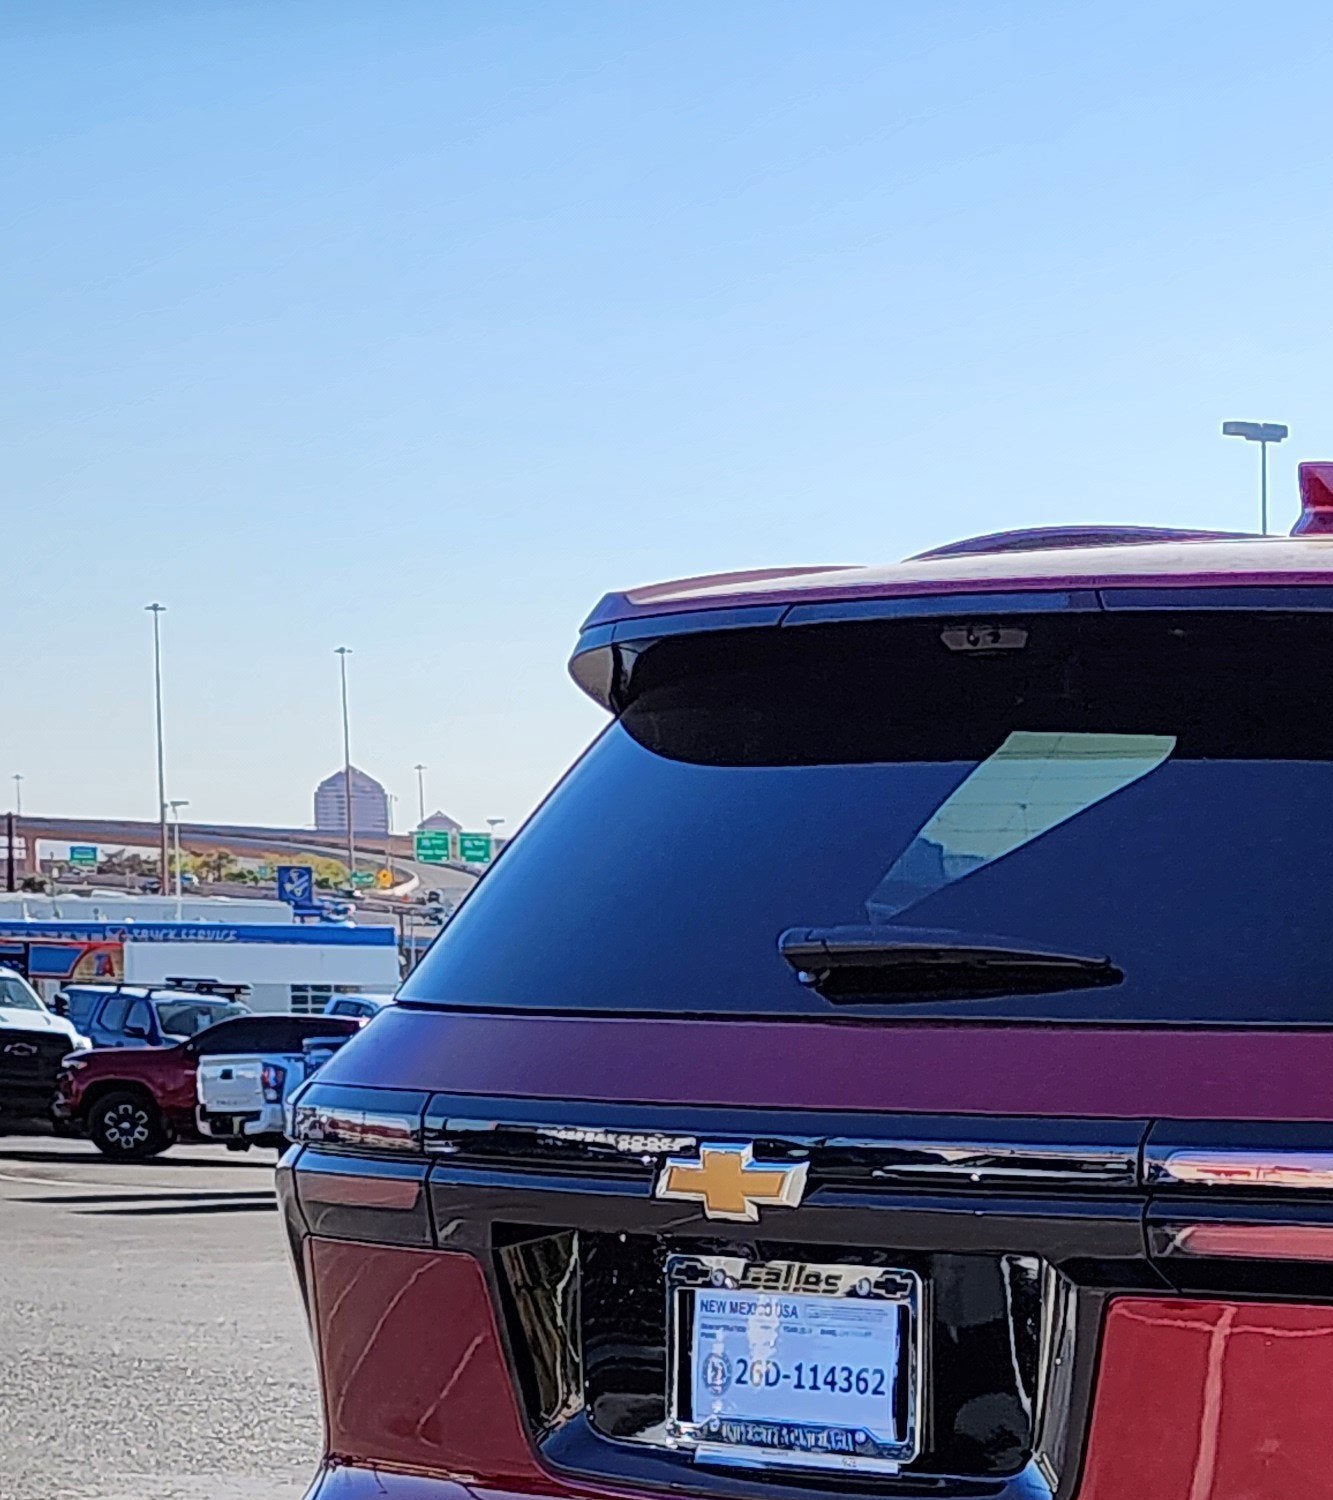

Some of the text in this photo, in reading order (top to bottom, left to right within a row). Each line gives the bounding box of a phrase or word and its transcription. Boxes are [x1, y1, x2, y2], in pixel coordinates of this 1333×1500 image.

[700, 1298, 726, 1315] NEW
[776, 1303, 799, 1320] USA
[735, 1357, 886, 1396] 26D-114362
